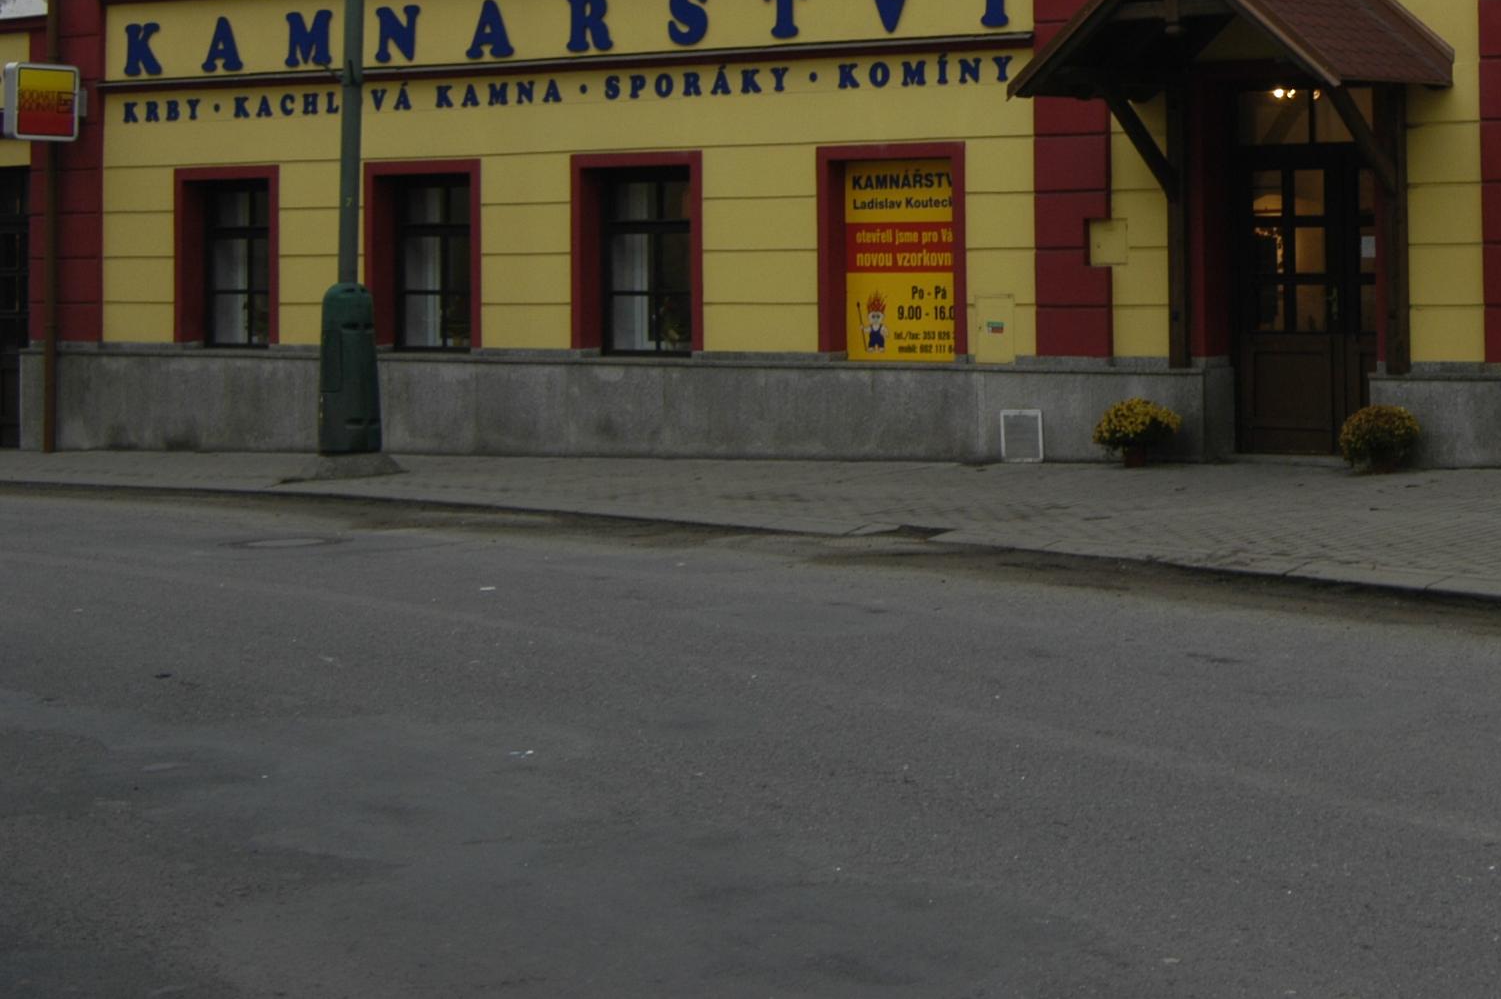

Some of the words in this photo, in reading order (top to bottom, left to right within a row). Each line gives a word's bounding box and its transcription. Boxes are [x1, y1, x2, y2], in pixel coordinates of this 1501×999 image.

[123, 97, 202, 124] KRBY
[233, 80, 413, 119] KACHLVÁ
[436, 78, 563, 109] KAMNA
[604, 63, 789, 101] SPORÁKY
[838, 52, 1014, 90] KOMÍNY
[853, 198, 902, 210] Ladislav
[895, 228, 919, 245] jsme
[921, 230, 938, 245] pro
[856, 251, 893, 267] novou
[911, 285, 925, 299] Po
[934, 285, 947, 299] Pá
[897, 305, 922, 320] 9.00
